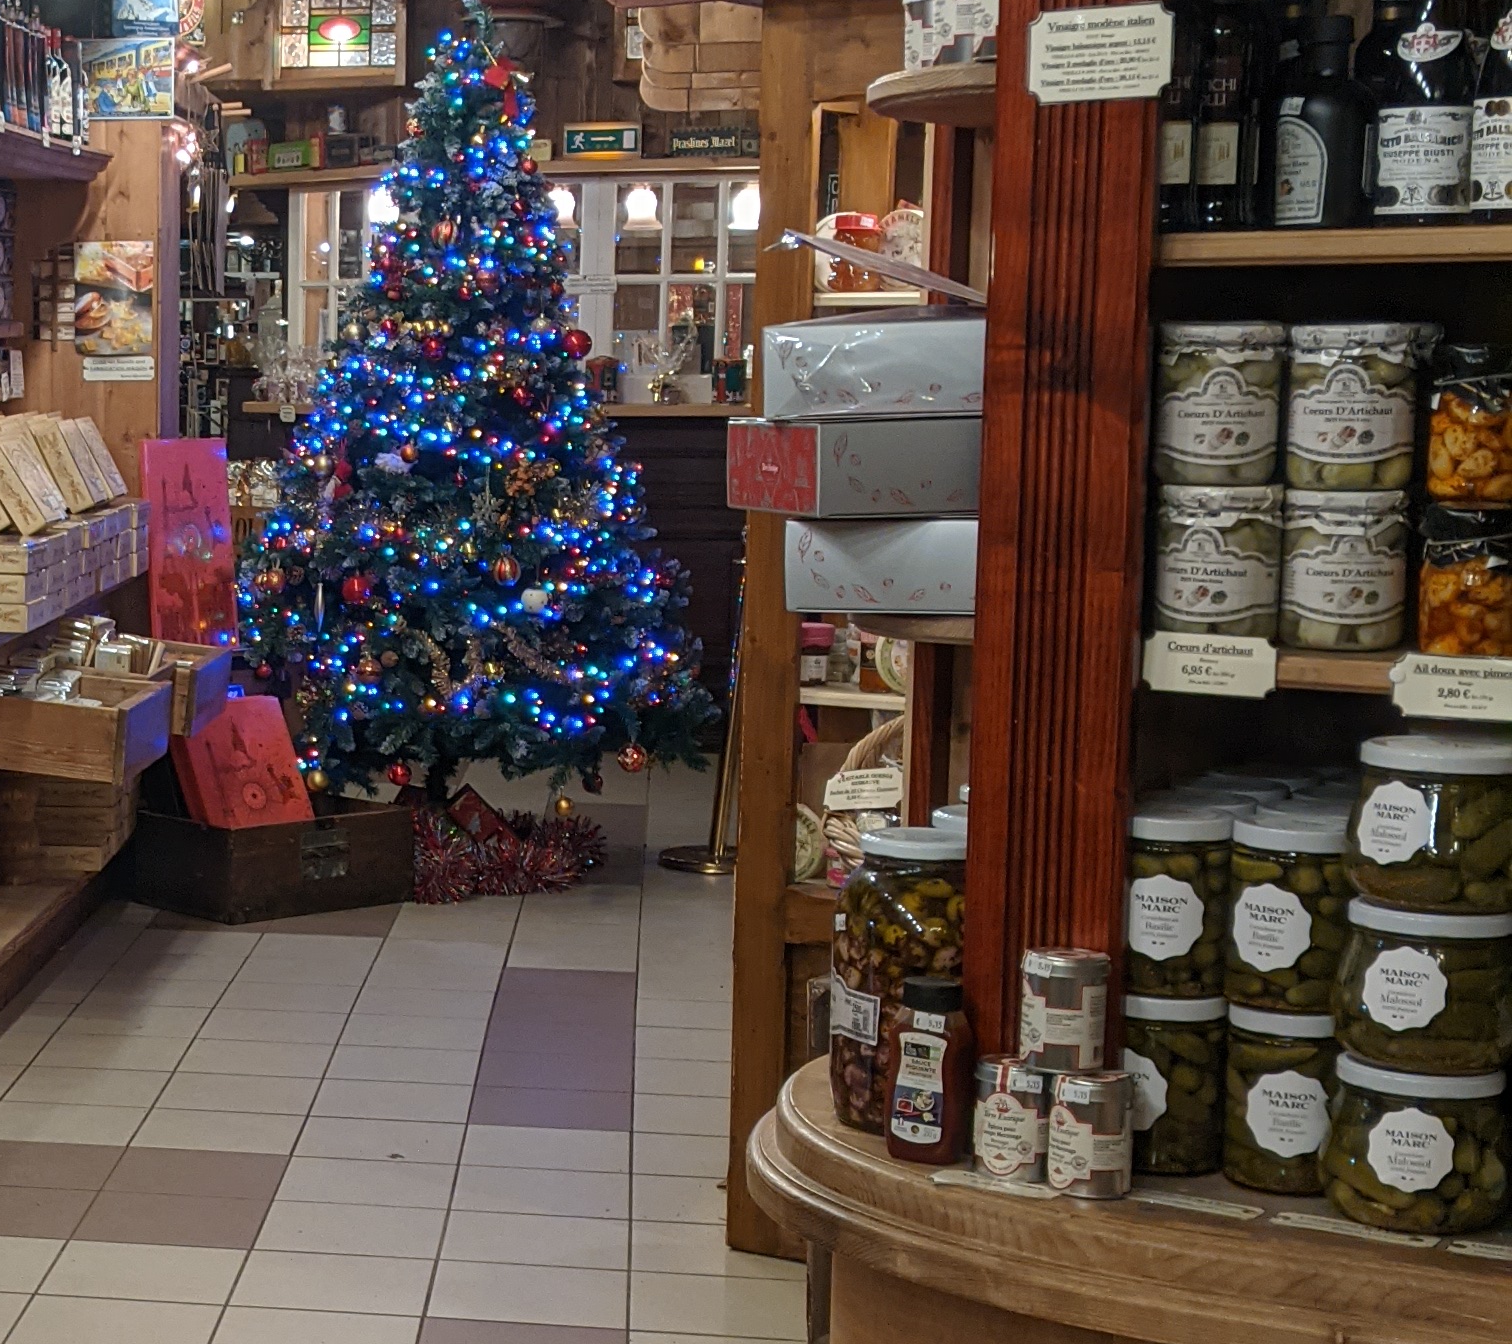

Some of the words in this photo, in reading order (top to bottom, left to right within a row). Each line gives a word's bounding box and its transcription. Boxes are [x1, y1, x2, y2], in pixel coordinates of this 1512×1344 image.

[1127, 16, 1155, 26] italien
[1423, 148, 1455, 157] GIUSTI
[1336, 405, 1394, 416] D'Artichaut
[1190, 566, 1249, 578] D'Artichaut
[1305, 567, 1340, 577] Coeurs
[1202, 642, 1254, 656] d'artichaut
[1181, 665, 1203, 676] 6,95
[1203, 665, 1212, 676] €
[1413, 664, 1429, 674] Ail
[1431, 665, 1456, 675] doux
[1458, 667, 1481, 676] avec
[1437, 687, 1461, 699] 2,80
[1463, 689, 1471, 699] €
[1373, 802, 1416, 815] MAISON
[1376, 811, 1409, 822] MARC
[1135, 893, 1189, 906] MAISON
[1141, 903, 1181, 914] MARC
[1244, 903, 1294, 916] MAISON
[1249, 912, 1287, 924] MARC
[1379, 967, 1431, 980] MAISON
[1384, 976, 1423, 988] MARC
[1379, 992, 1423, 1007] Malossol
[911, 1058, 932, 1067] SAUCE
[1262, 1089, 1318, 1101] MAISON
[1268, 1099, 1310, 1110] MARC
[1384, 1129, 1438, 1142] MAISON
[1391, 1138, 1431, 1149] MARC
[1387, 1155, 1432, 1169] Malossol
